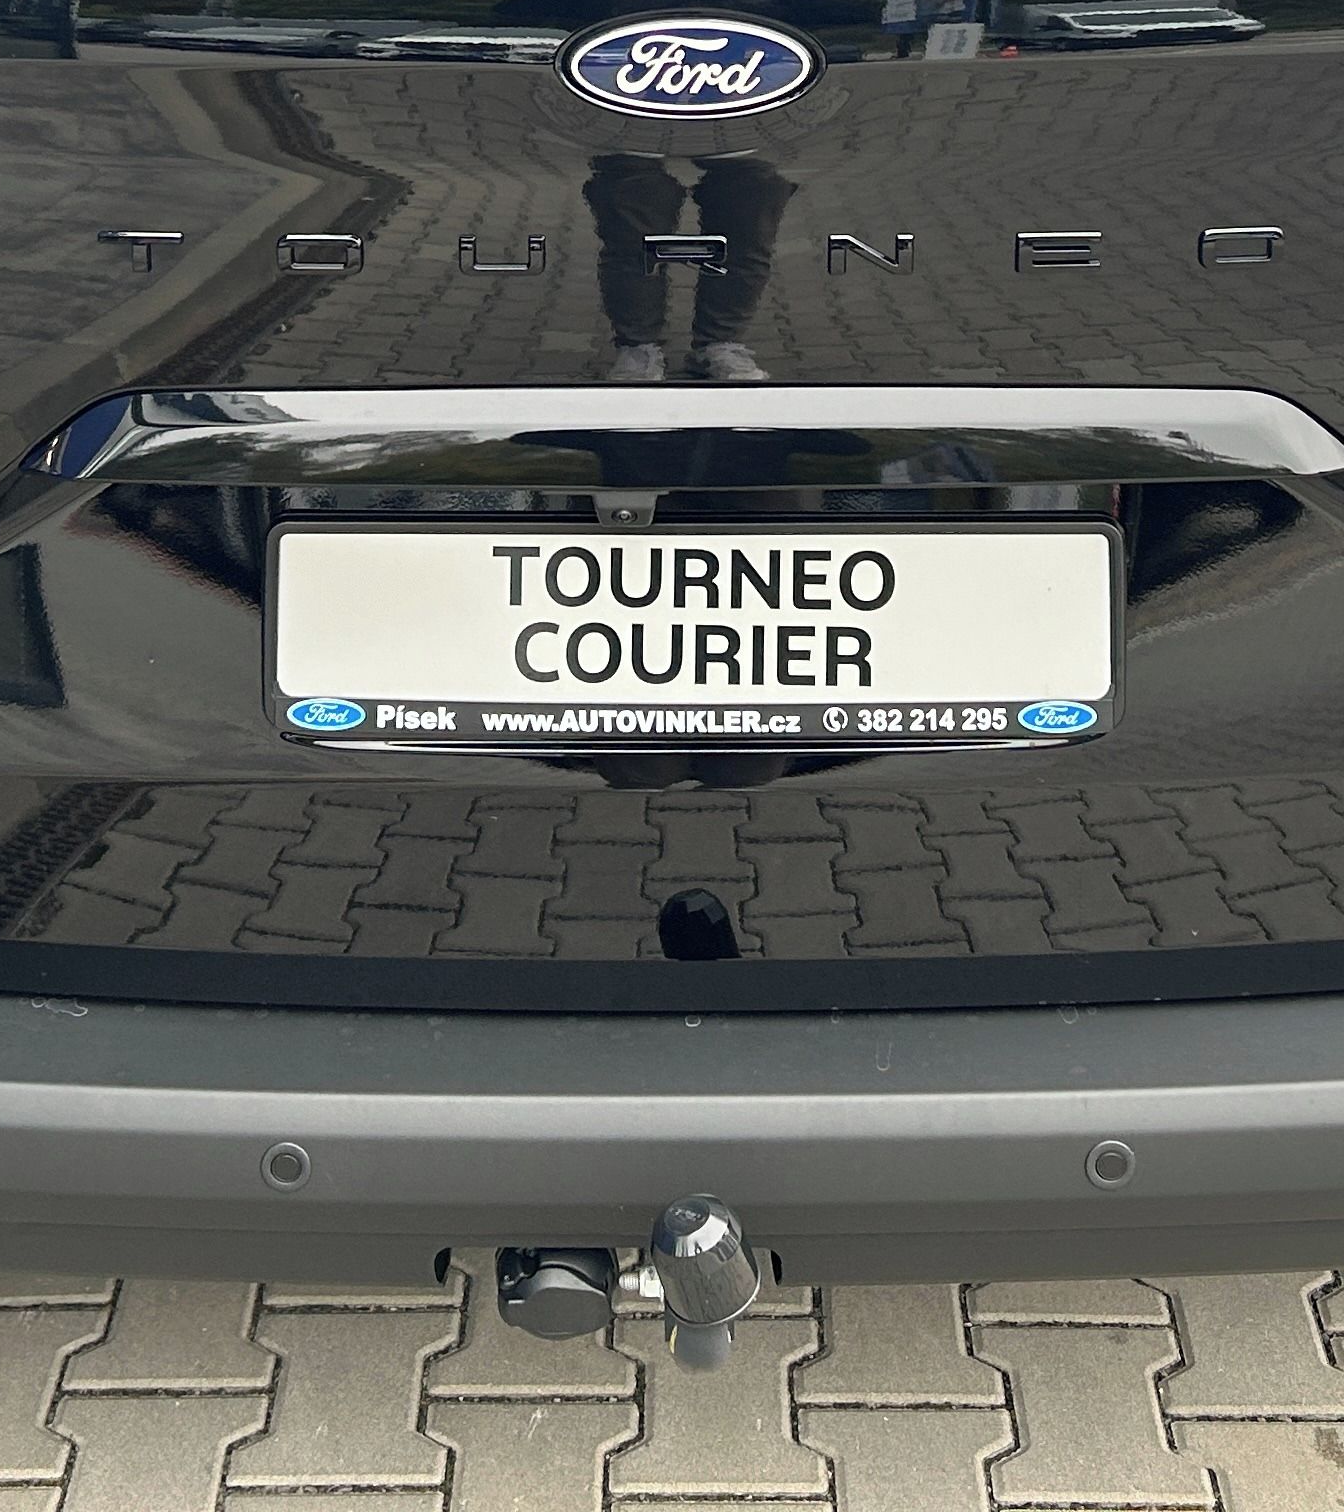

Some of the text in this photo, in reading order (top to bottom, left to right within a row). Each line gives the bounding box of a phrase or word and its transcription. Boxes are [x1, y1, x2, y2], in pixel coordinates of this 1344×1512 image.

[616, 34, 764, 94] Ford
[96, 226, 1287, 279] TOURNEO
[492, 545, 895, 611] TOURNEO
[514, 621, 872, 687] COURIER
[376, 703, 456, 730] Písek
[481, 709, 801, 734] www.AUTOVINKLER.cz
[857, 709, 903, 732] 382
[909, 709, 955, 732] 214
[961, 708, 1008, 731] 295
